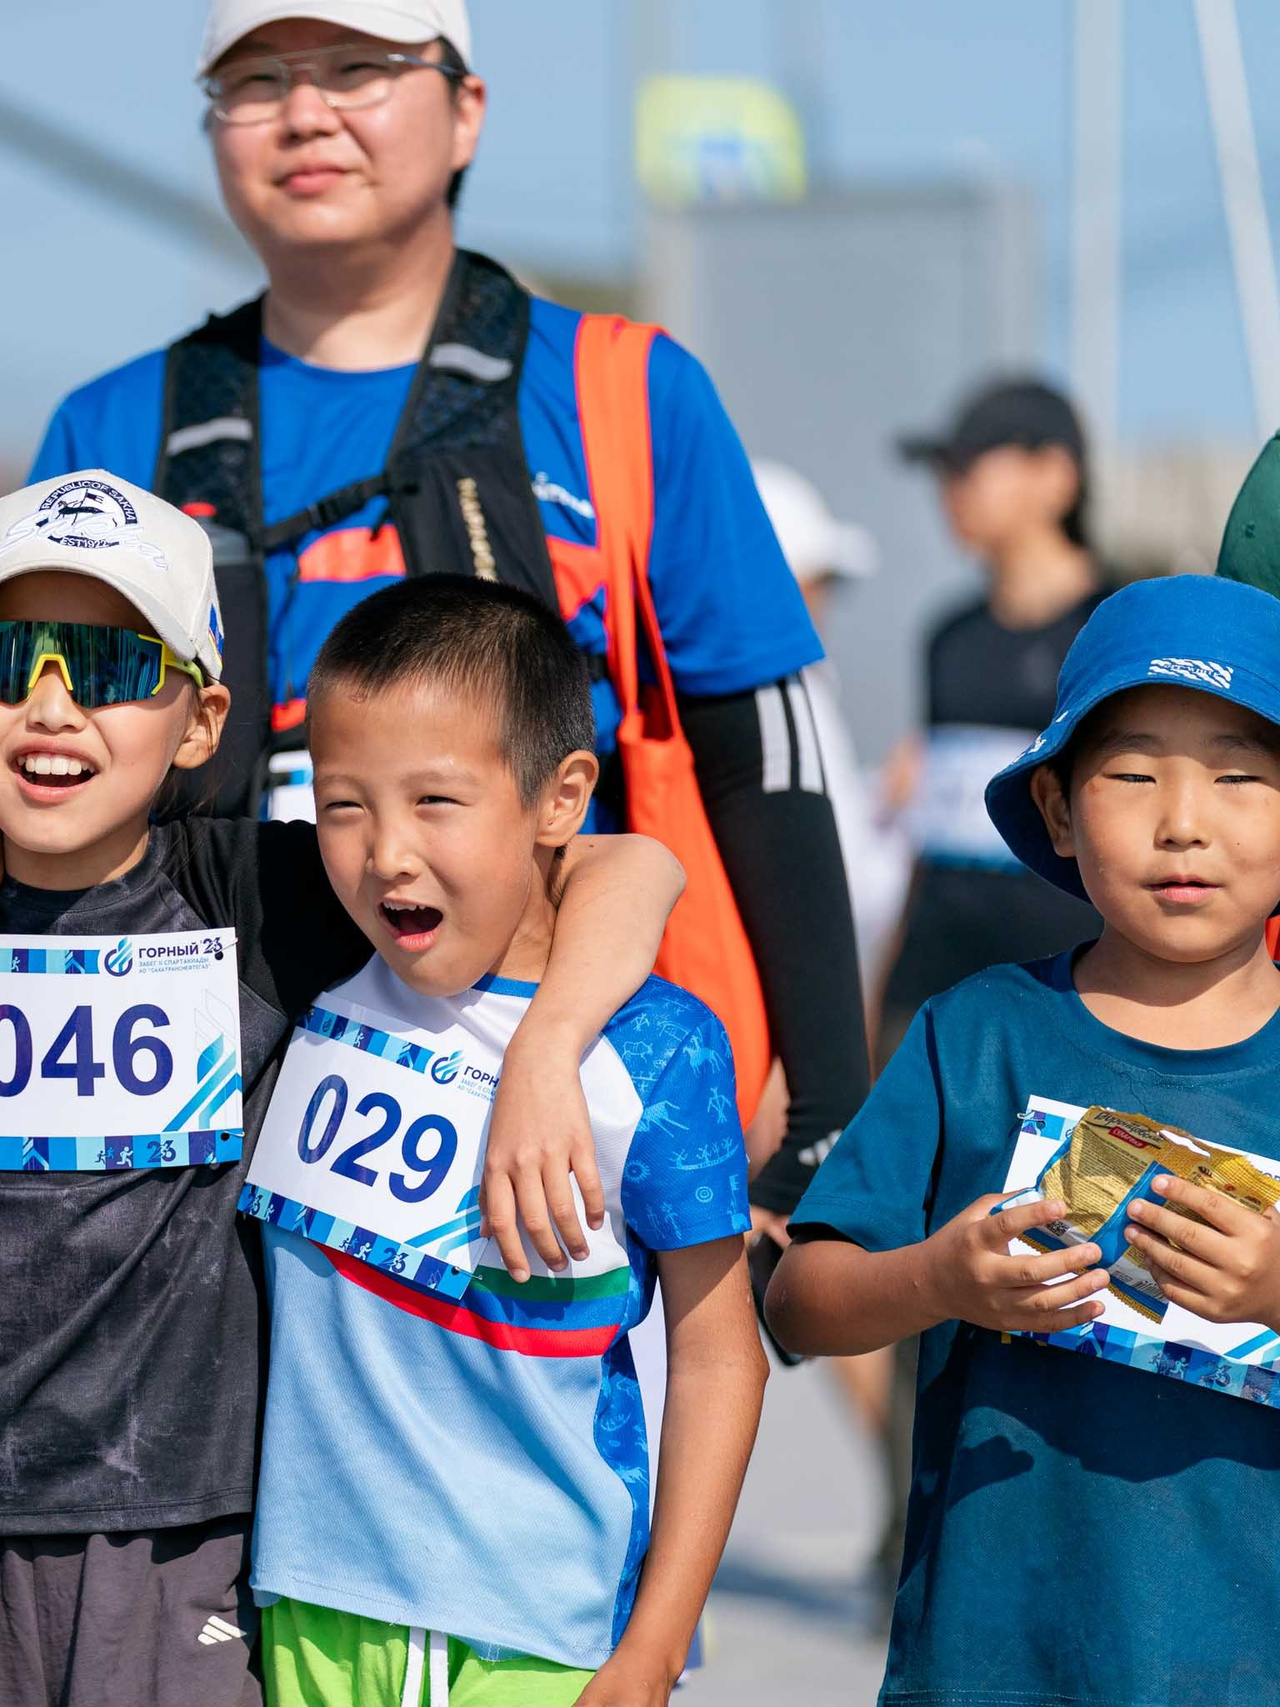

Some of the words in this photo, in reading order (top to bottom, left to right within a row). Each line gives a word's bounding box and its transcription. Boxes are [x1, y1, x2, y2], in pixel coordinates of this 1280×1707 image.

[42, 481, 90, 509] REPUBLIC
[109, 490, 137, 520] SAKHA
[139, 942, 199, 958] ГОРНЫЙ
[463, 1066, 500, 1088] ГОРН
[297, 1074, 458, 1203] 029
